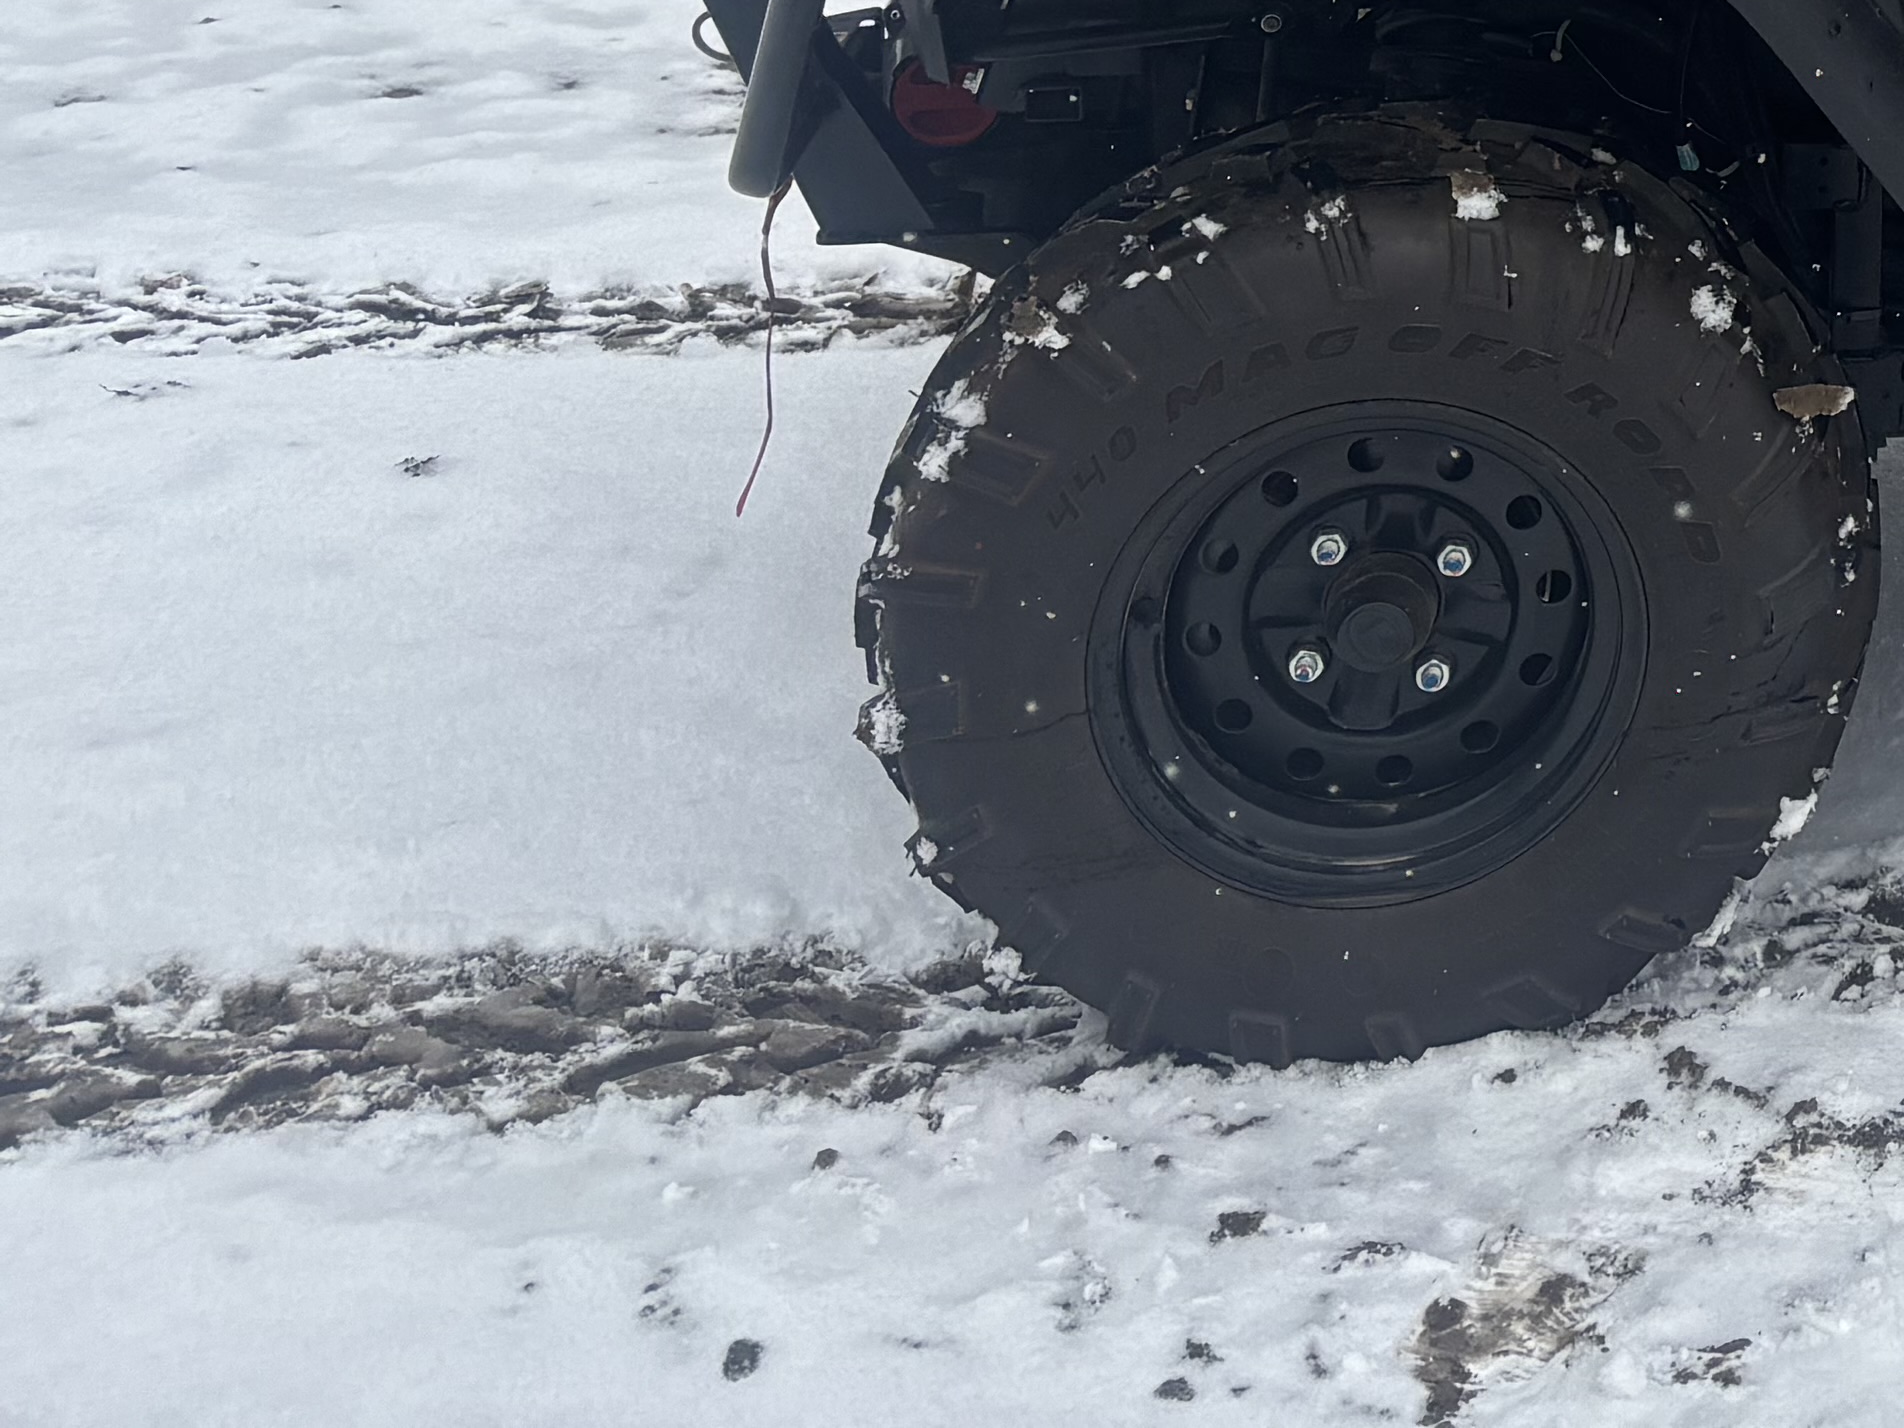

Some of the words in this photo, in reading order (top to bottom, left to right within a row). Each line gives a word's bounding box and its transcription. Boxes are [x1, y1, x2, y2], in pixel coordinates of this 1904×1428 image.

[1047, 424, 1138, 531] 440
[1386, 322, 1565, 376] OFF
[1562, 381, 1723, 564] ROAD
